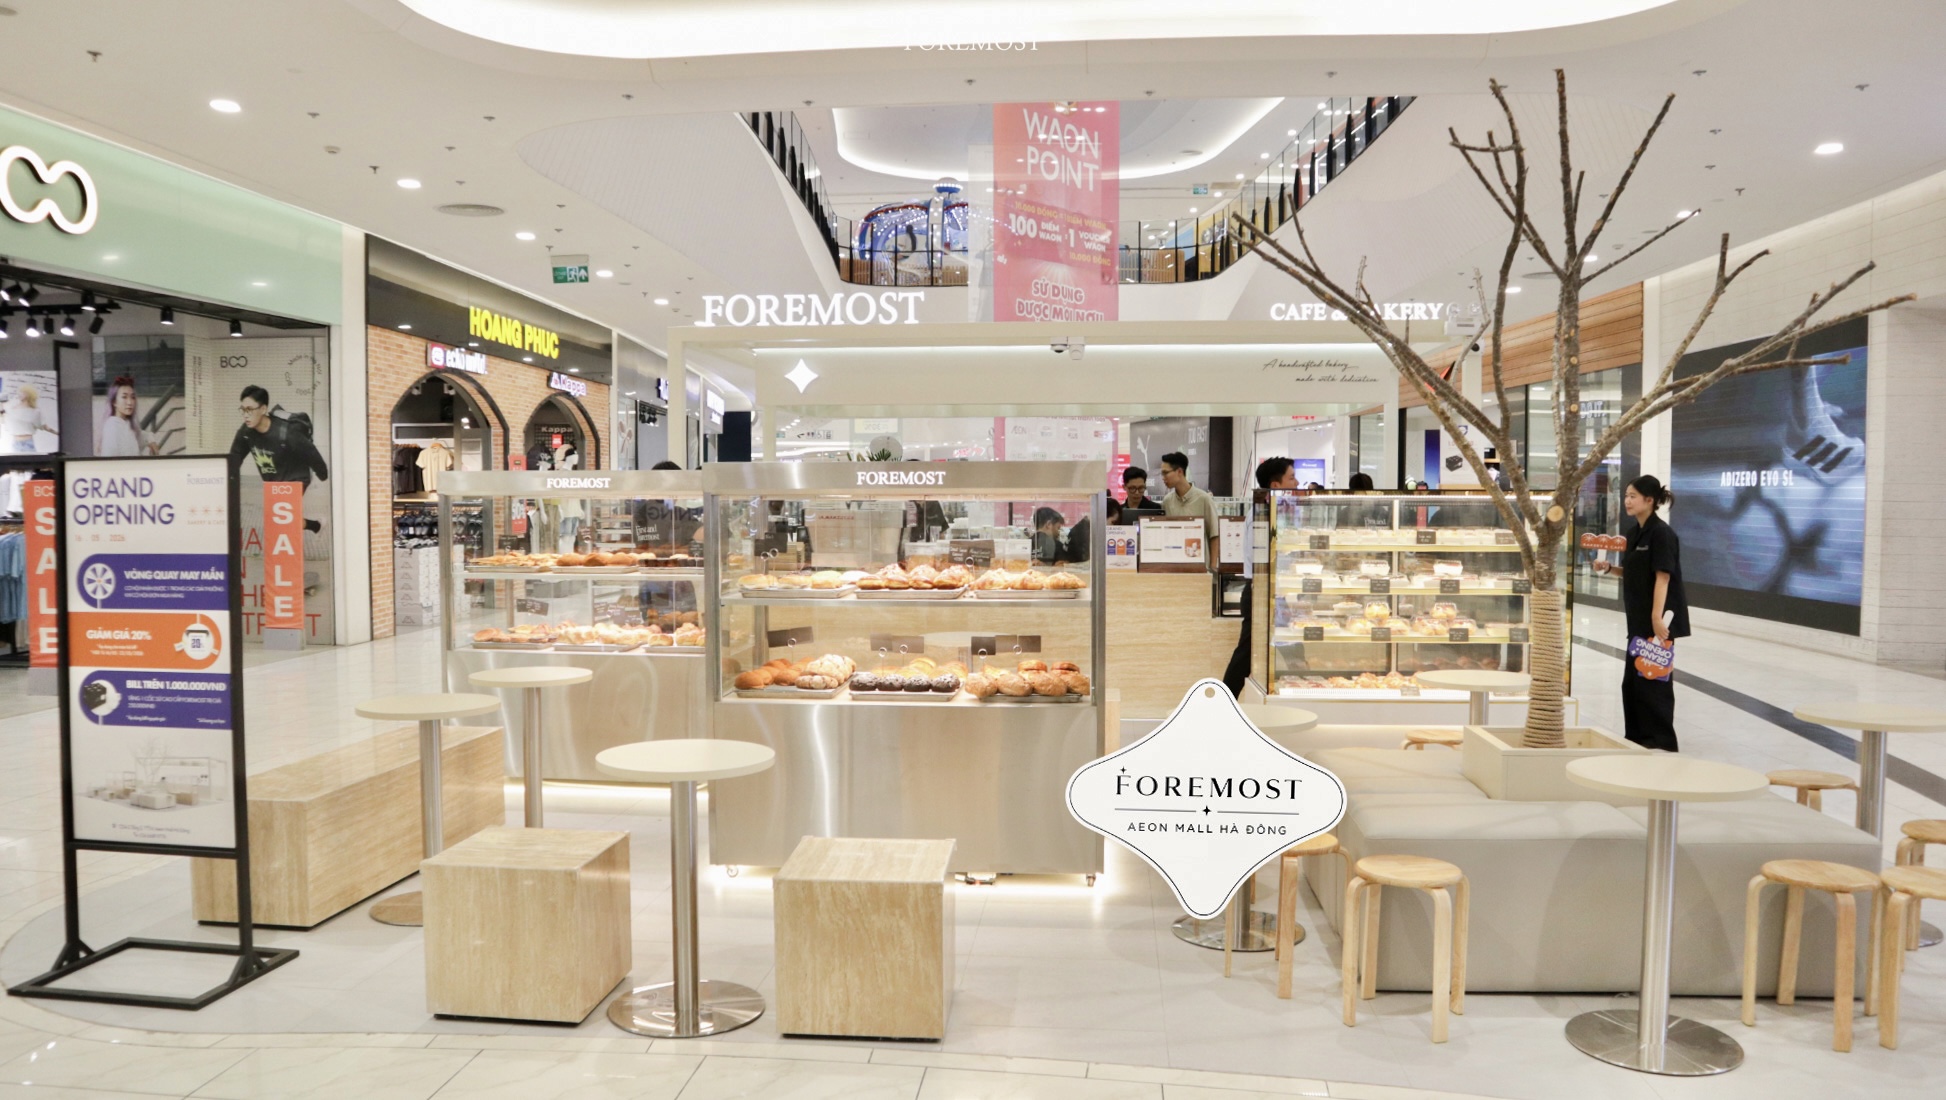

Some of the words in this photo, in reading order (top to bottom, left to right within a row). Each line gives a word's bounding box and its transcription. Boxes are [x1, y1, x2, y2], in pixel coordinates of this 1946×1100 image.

[1023, 108, 1099, 159] WAON
[1027, 145, 1099, 191] POINT
[1009, 213, 1037, 238] 100
[1039, 231, 1062, 242] WAON
[694, 291, 924, 327] FOREMOST
[1270, 303, 1327, 320] CAFE
[469, 306, 523, 349] HOANG
[524, 324, 559, 359] PHUC
[560, 374, 587, 396] Kappa
[541, 426, 573, 434] Kappa
[72, 477, 153, 499] GRAND
[546, 477, 611, 488] FOREMOST
[857, 471, 946, 485] FOREMOST
[1720, 470, 1757, 487] ADIZERO
[1760, 470, 1779, 487] EVO
[1782, 469, 1794, 487] SL
[73, 503, 175, 526] OPENING
[271, 501, 295, 617] SALE
[124, 567, 152, 580] VÒNG
[153, 570, 179, 580] QUAY
[180, 571, 200, 580] MAY
[1635, 638, 1672, 659] OPENING
[1639, 649, 1669, 666] GRAND
[126, 680, 142, 689] BILL
